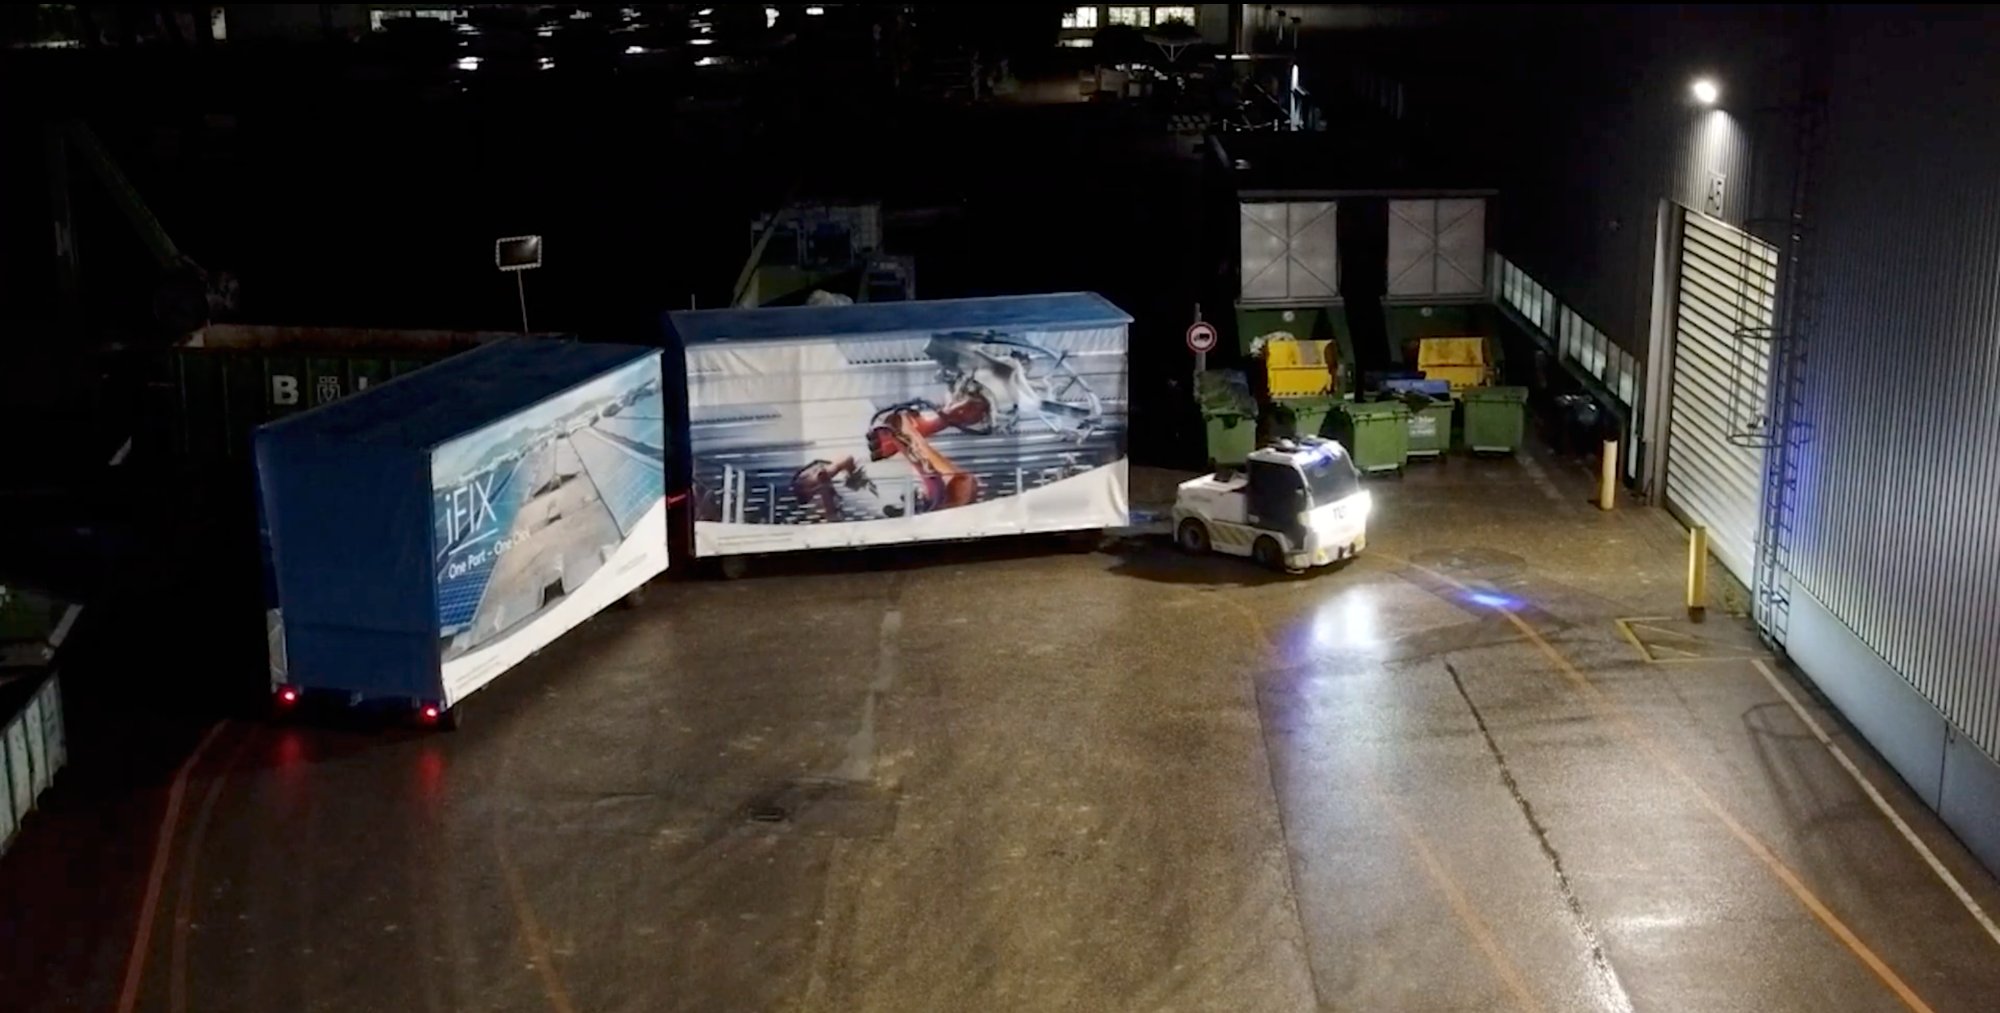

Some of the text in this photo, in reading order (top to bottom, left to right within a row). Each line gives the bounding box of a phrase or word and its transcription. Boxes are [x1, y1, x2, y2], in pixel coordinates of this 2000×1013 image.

[445, 473, 497, 545] iFIX
[448, 562, 467, 579] One
[467, 549, 487, 571] Part
[494, 540, 513, 556] One
